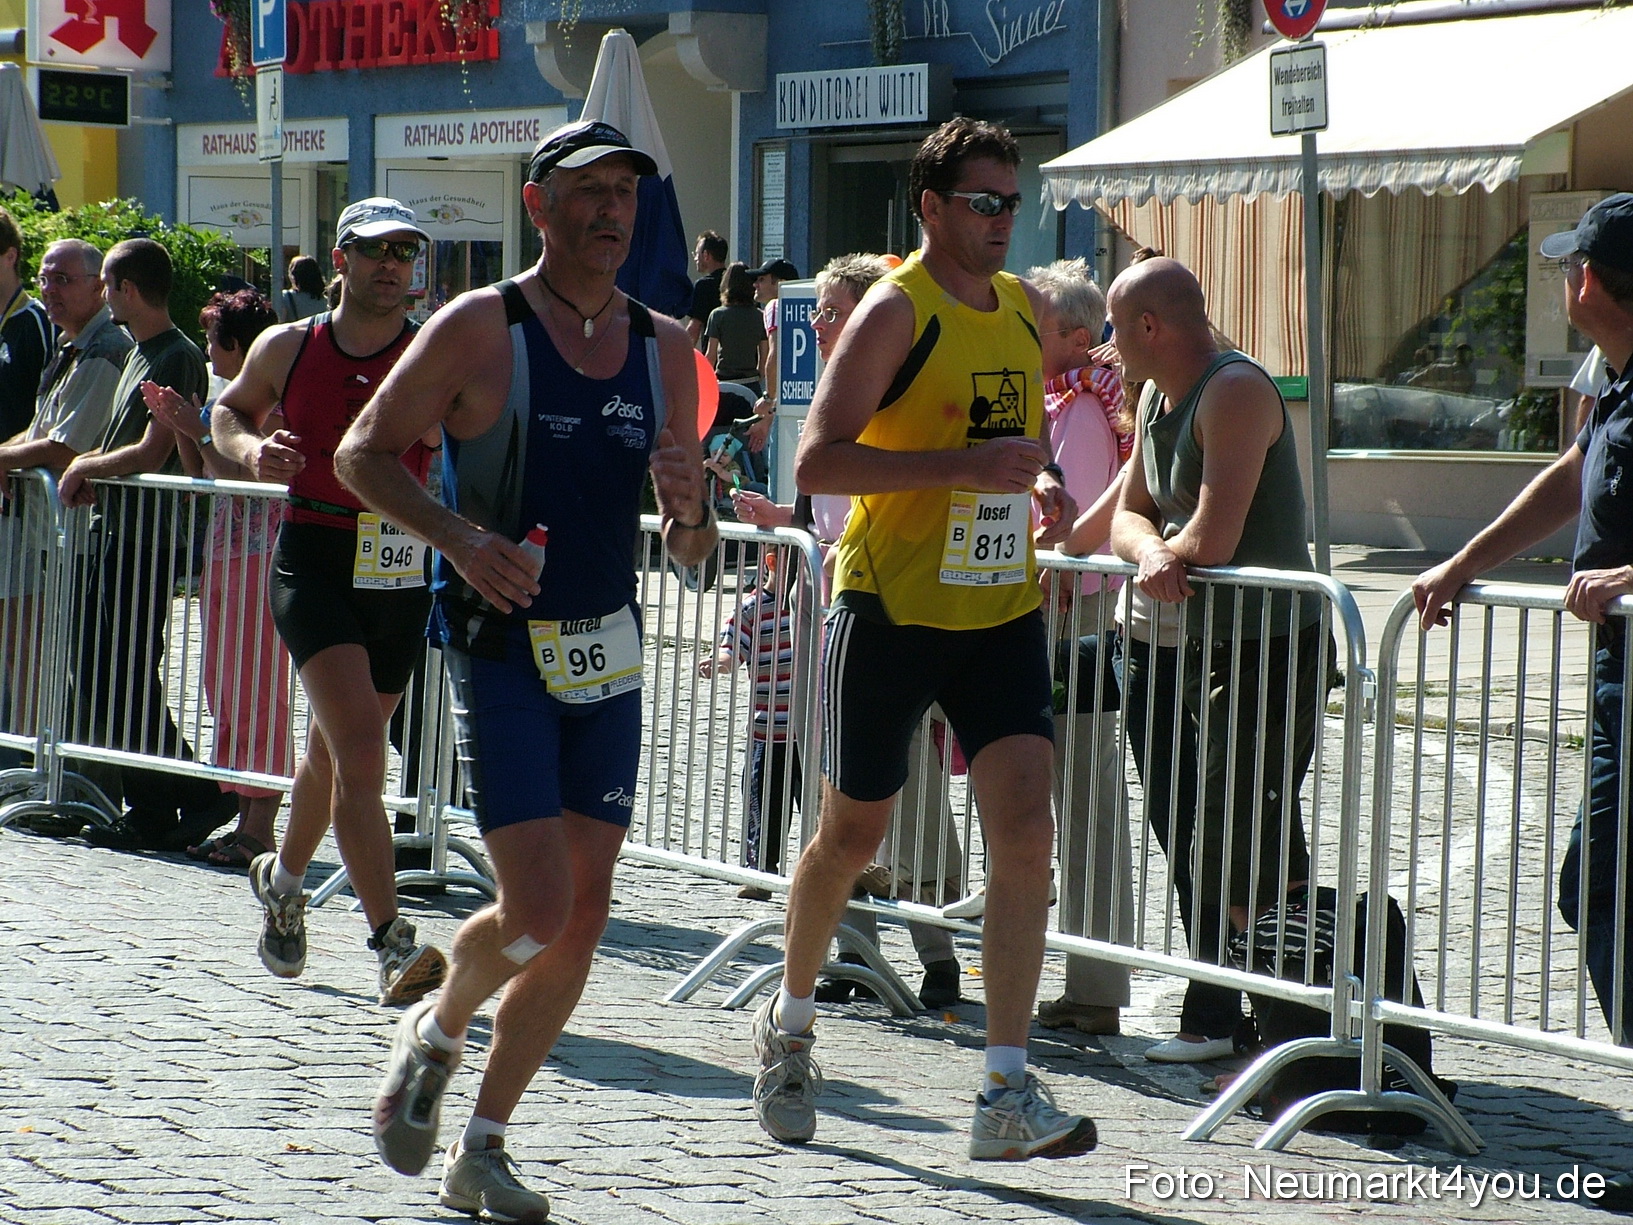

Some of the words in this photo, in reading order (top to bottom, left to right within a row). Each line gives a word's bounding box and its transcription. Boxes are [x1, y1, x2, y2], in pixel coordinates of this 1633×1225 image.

[258, 0, 276, 48] P
[923, 0, 950, 38] DER
[1273, 60, 1323, 86] Wendebereich
[779, 75, 868, 123] KONDITOREI
[879, 72, 923, 117] WITTL
[1281, 95, 1315, 117] freihalten
[202, 132, 257, 155] RATHAUS
[404, 123, 465, 147] RATHAUS
[469, 118, 540, 144] APOTHEKE
[210, 202, 229, 212] Haus
[229, 200, 242, 208] der
[408, 197, 429, 207] Haus
[429, 194, 442, 202] der
[443, 194, 486, 209] Gesundheit
[792, 328, 807, 374] P
[782, 380, 814, 400] SCHEINE
[549, 422, 573, 432] KOLB
[1610, 465, 1623, 496] adidas
[976, 503, 1012, 521] Josef
[952, 527, 965, 541] B
[362, 540, 372, 553] B
[380, 545, 413, 569] 946
[974, 532, 1016, 561] 813
[541, 647, 556, 665] B
[568, 643, 607, 677] 96
